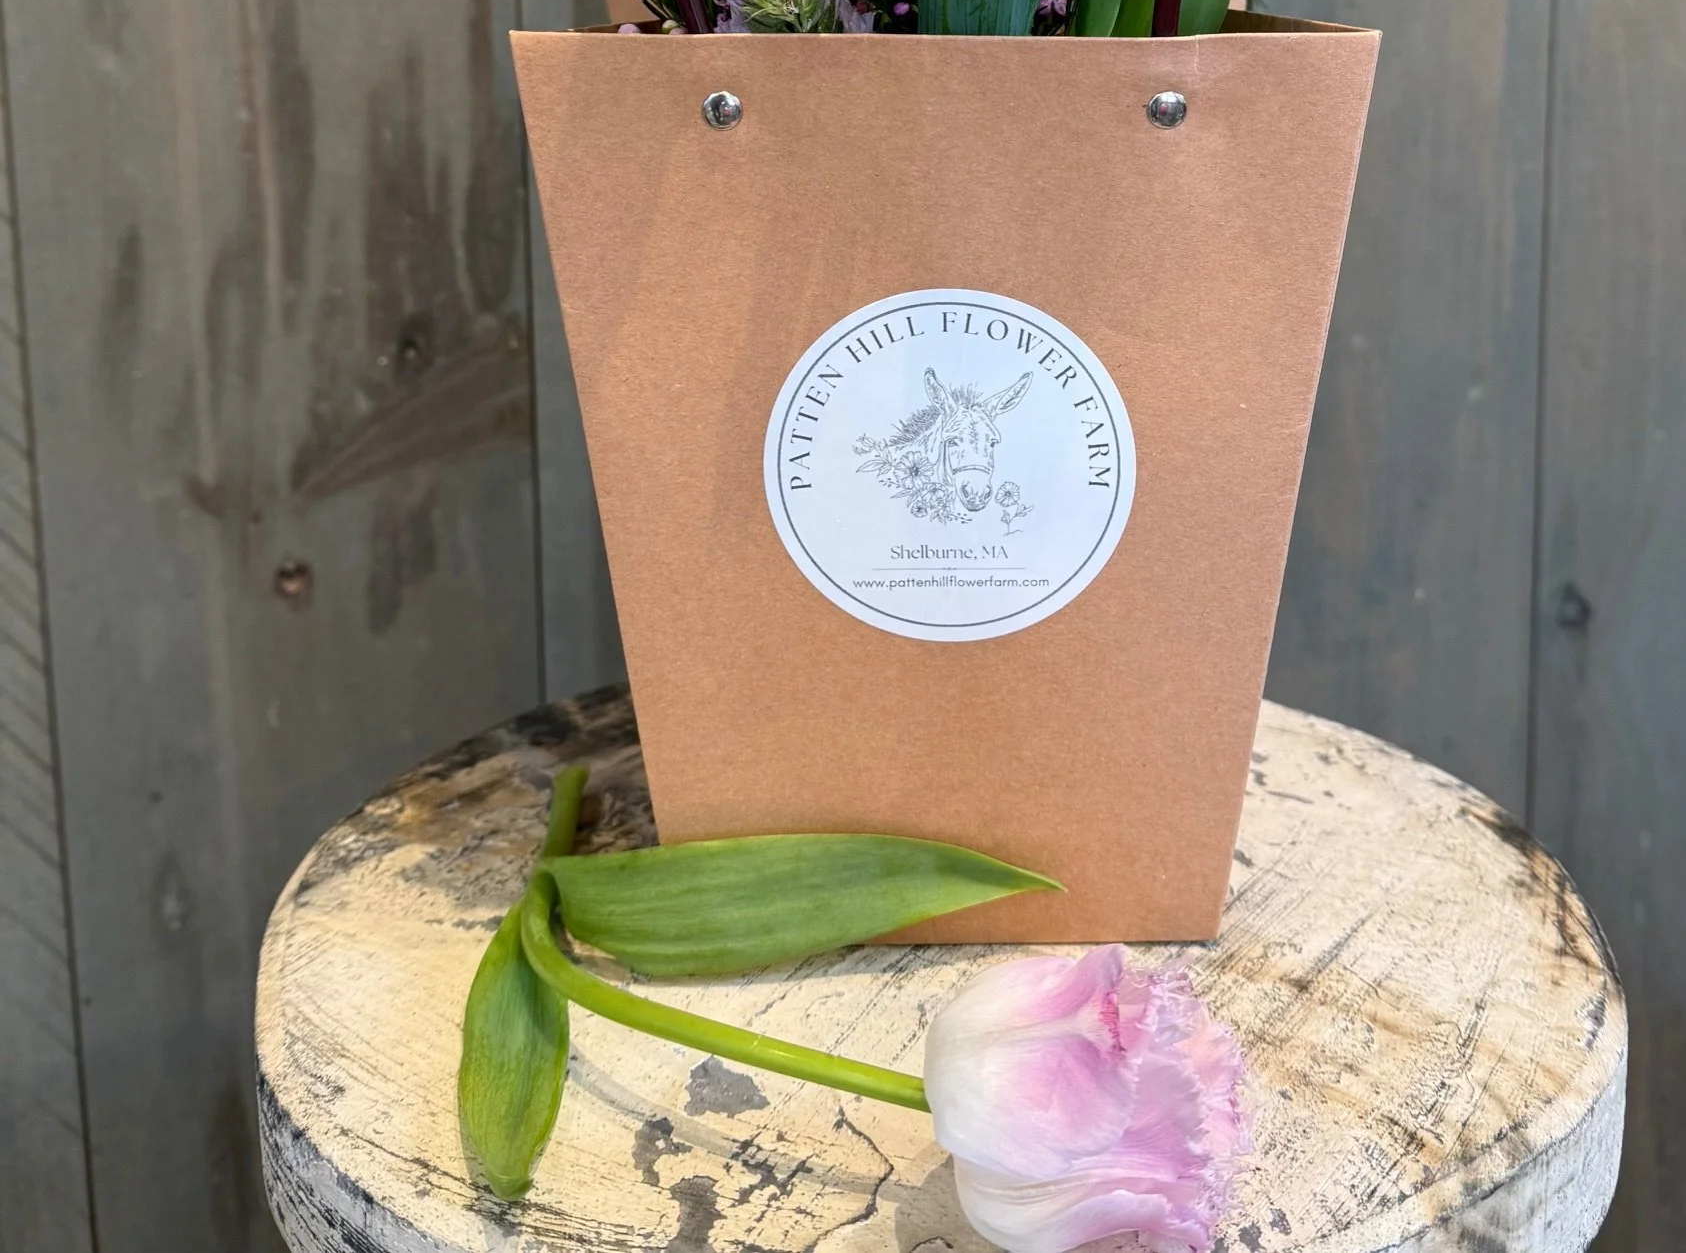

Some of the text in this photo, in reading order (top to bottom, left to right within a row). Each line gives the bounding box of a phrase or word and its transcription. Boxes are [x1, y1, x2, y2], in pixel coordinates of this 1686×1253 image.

[788, 311, 1111, 490] PATTEN HILL FLOWER FARM
[889, 544, 1009, 561] Shelburne, MA
[853, 574, 1050, 590] www.pattenhillflowerfarm.com
